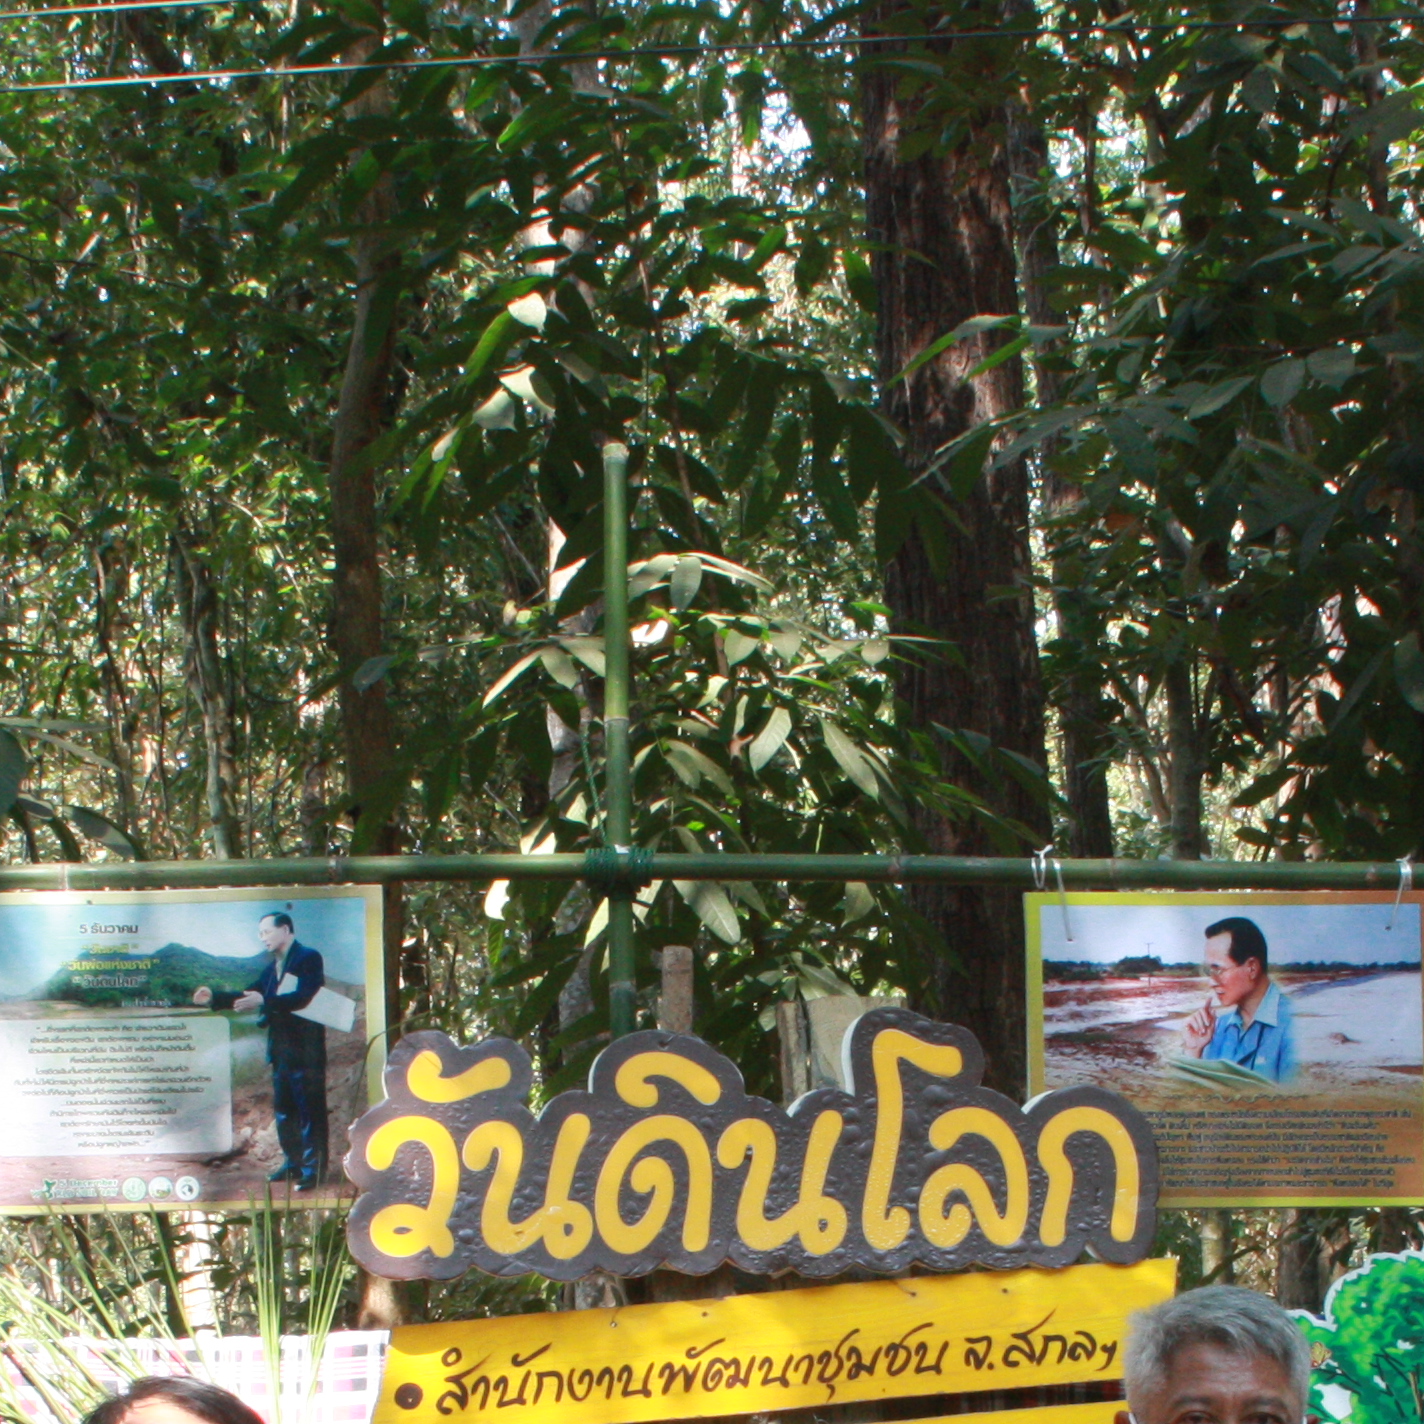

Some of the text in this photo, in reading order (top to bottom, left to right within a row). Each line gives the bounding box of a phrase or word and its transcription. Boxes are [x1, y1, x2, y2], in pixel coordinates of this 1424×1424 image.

[79, 924, 87, 934] 5
[366, 1028, 1139, 1260] วันดินโลก
[435, 1323, 949, 1416] สำนักงานพัฒนาชุมชน
